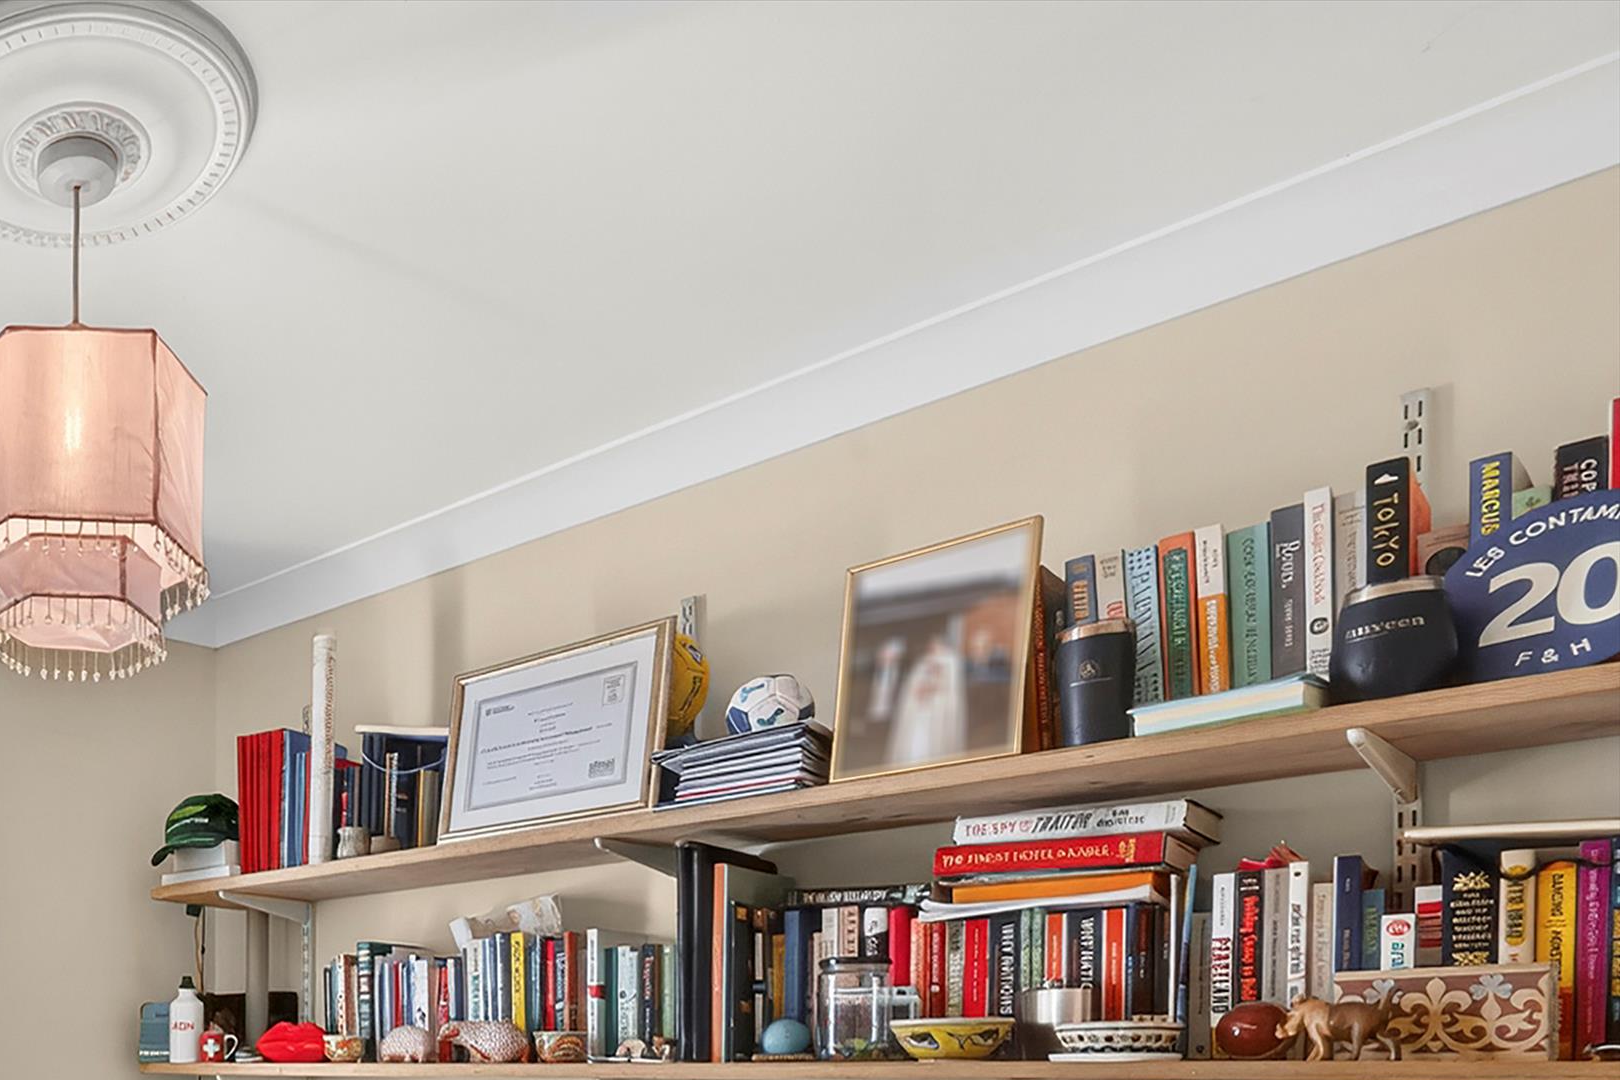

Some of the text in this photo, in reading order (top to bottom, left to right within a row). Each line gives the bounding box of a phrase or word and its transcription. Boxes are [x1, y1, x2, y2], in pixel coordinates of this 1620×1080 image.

[1465, 545, 1505, 578] LES
[1478, 541, 1620, 648] 20
[1514, 637, 1592, 668] F & H
